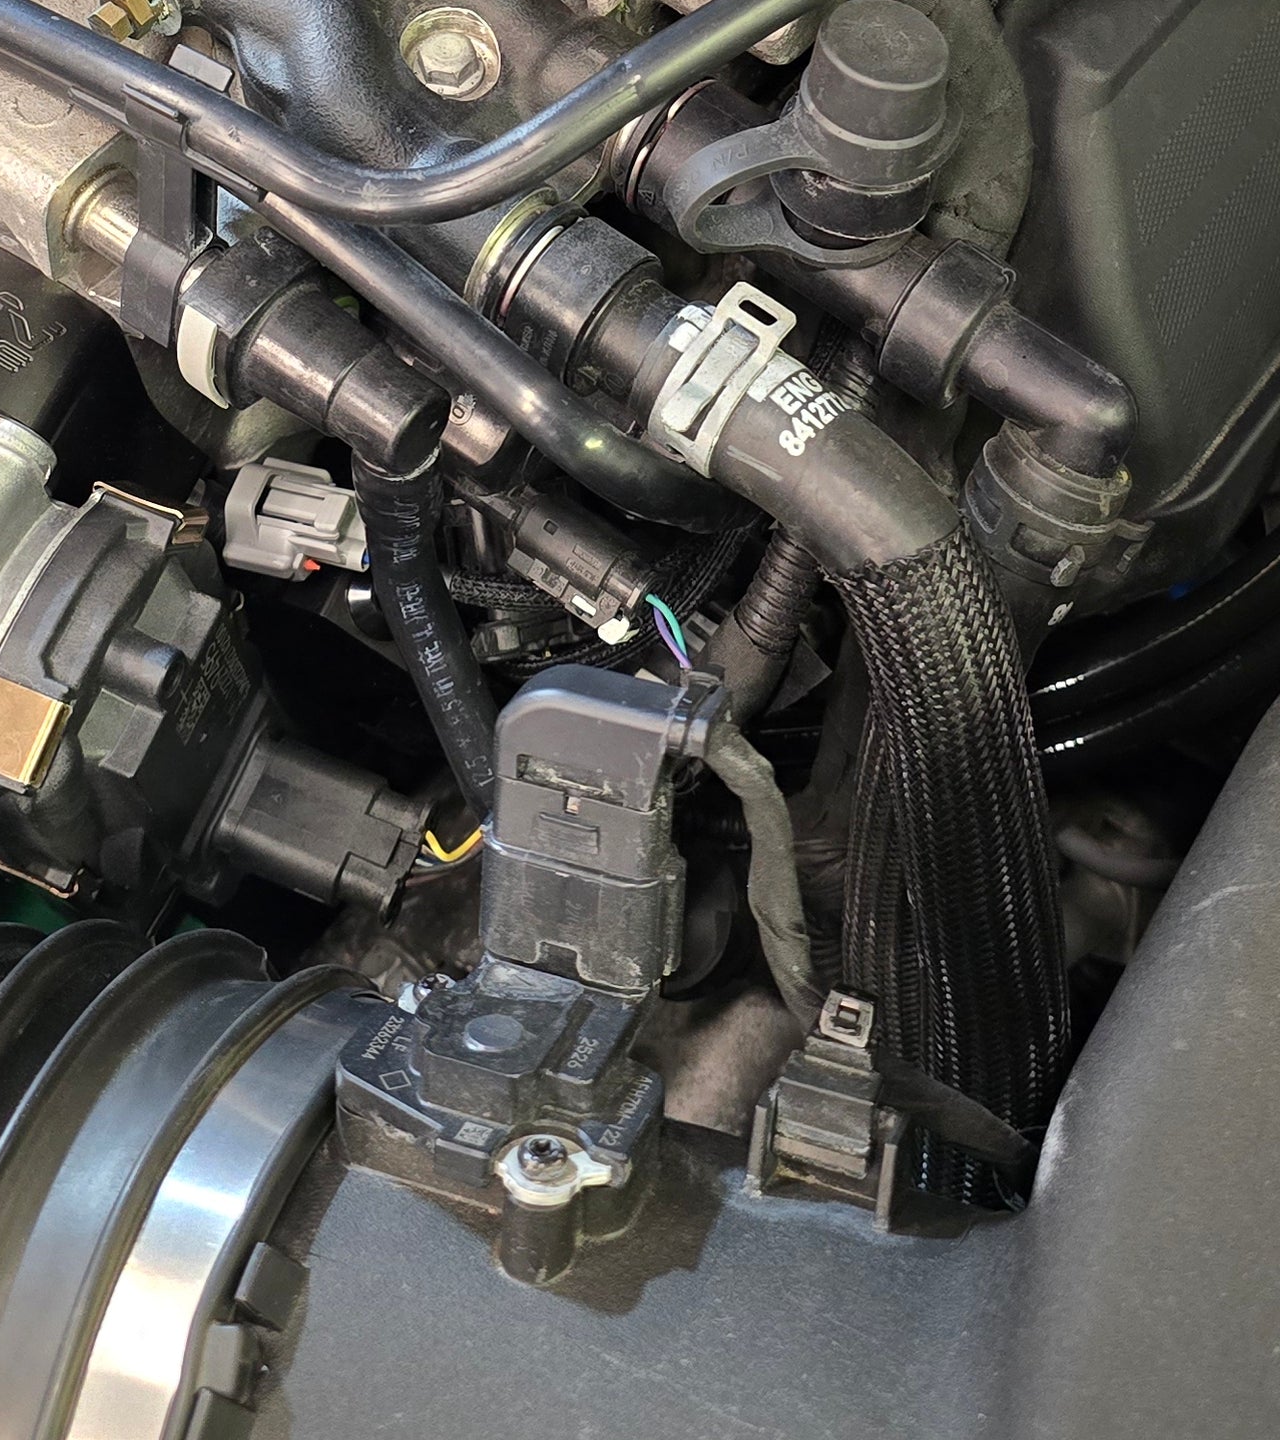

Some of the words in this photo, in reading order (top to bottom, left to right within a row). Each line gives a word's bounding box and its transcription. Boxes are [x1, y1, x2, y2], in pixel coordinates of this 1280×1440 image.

[769, 370, 824, 416] ENG
[361, 1014, 405, 1061] 23262344
[566, 1037, 599, 1070] 2526
